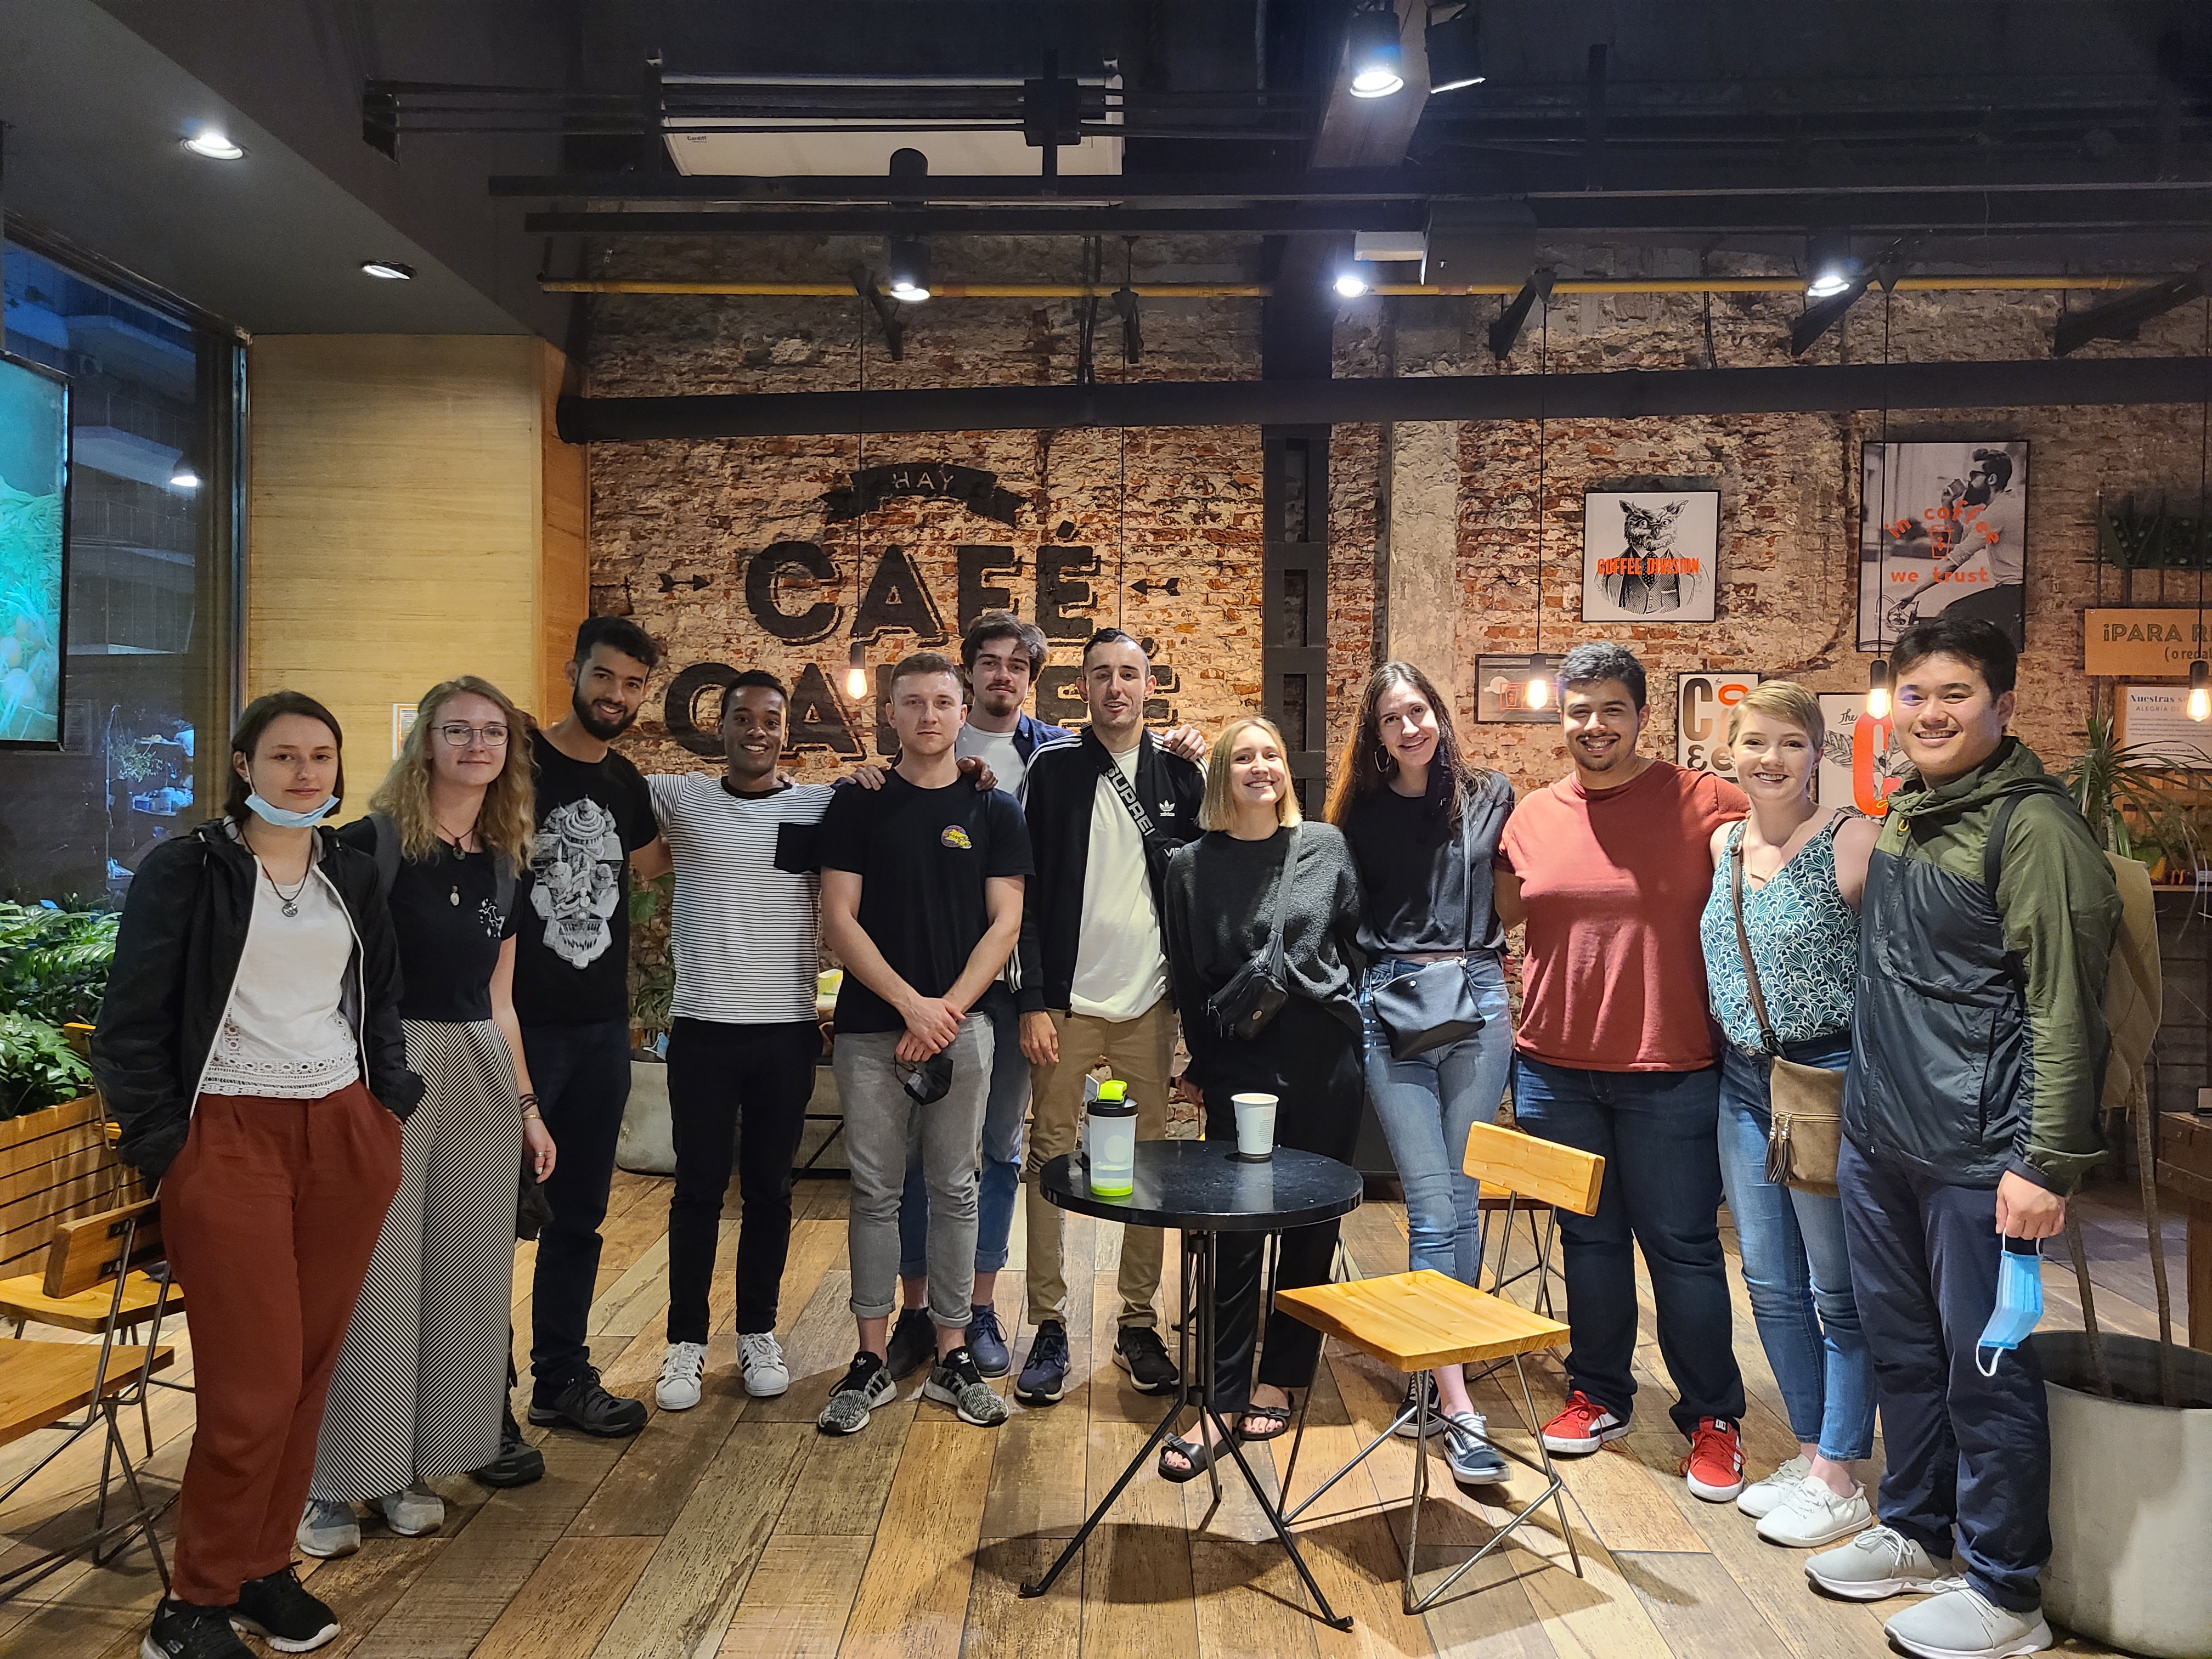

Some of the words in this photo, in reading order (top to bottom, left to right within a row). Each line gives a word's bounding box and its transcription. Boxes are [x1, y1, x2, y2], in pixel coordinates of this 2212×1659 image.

[892, 471, 954, 491] HAY
[1884, 519, 1911, 539] in
[1924, 500, 1999, 544] coffee
[1597, 557, 1643, 574] COFFEE
[1647, 557, 1699, 574] DIVISION
[1891, 571, 1918, 583] we
[1932, 566, 1989, 583] trust
[745, 521, 1101, 646] CAFÉ
[2131, 695, 2174, 703] Nuestras
[1838, 708, 1858, 725] The
